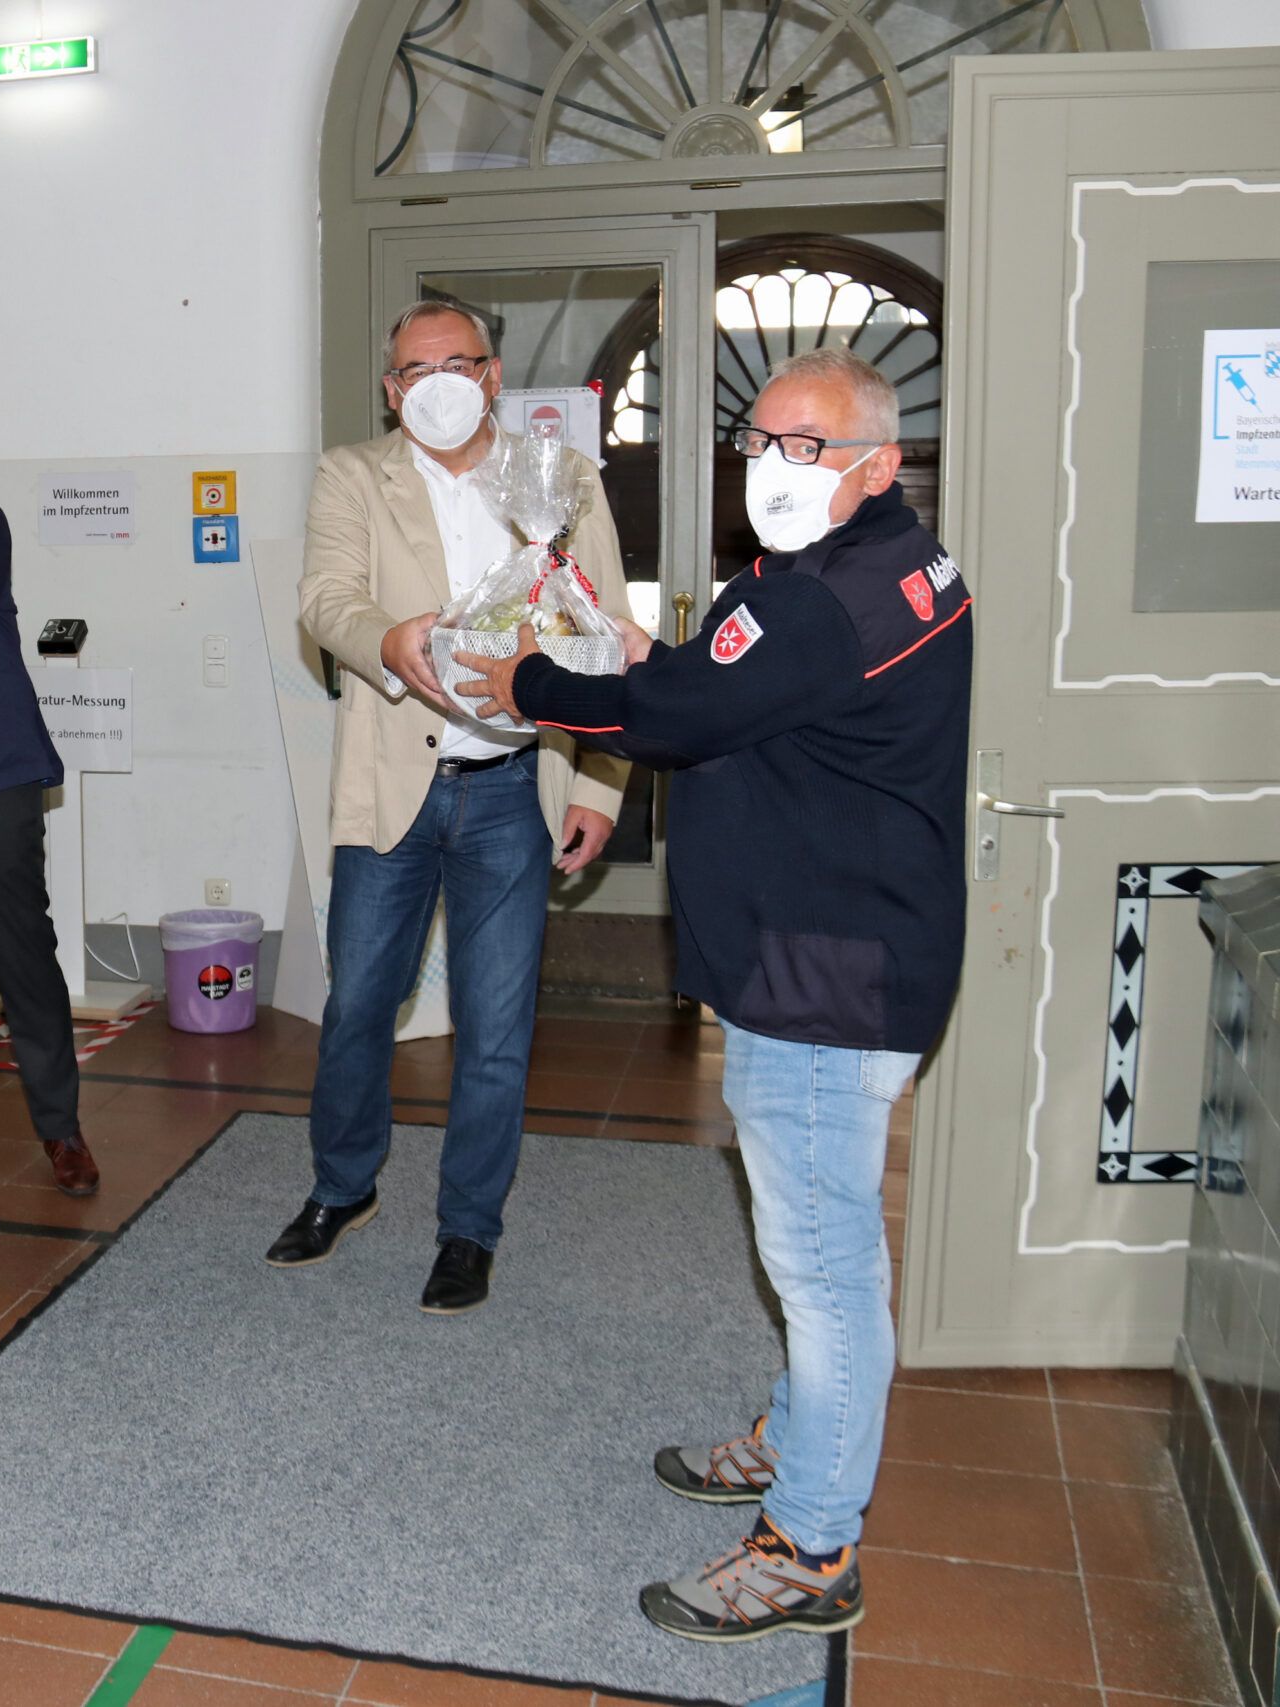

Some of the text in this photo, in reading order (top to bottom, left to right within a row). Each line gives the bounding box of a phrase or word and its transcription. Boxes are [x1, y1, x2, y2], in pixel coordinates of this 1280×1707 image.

[52, 489, 120, 500] Willkommen
[43, 504, 129, 519] im Impfzentrum
[37, 694, 126, 710] ratur-Messung
[58, 729, 106, 740] abnehmen
